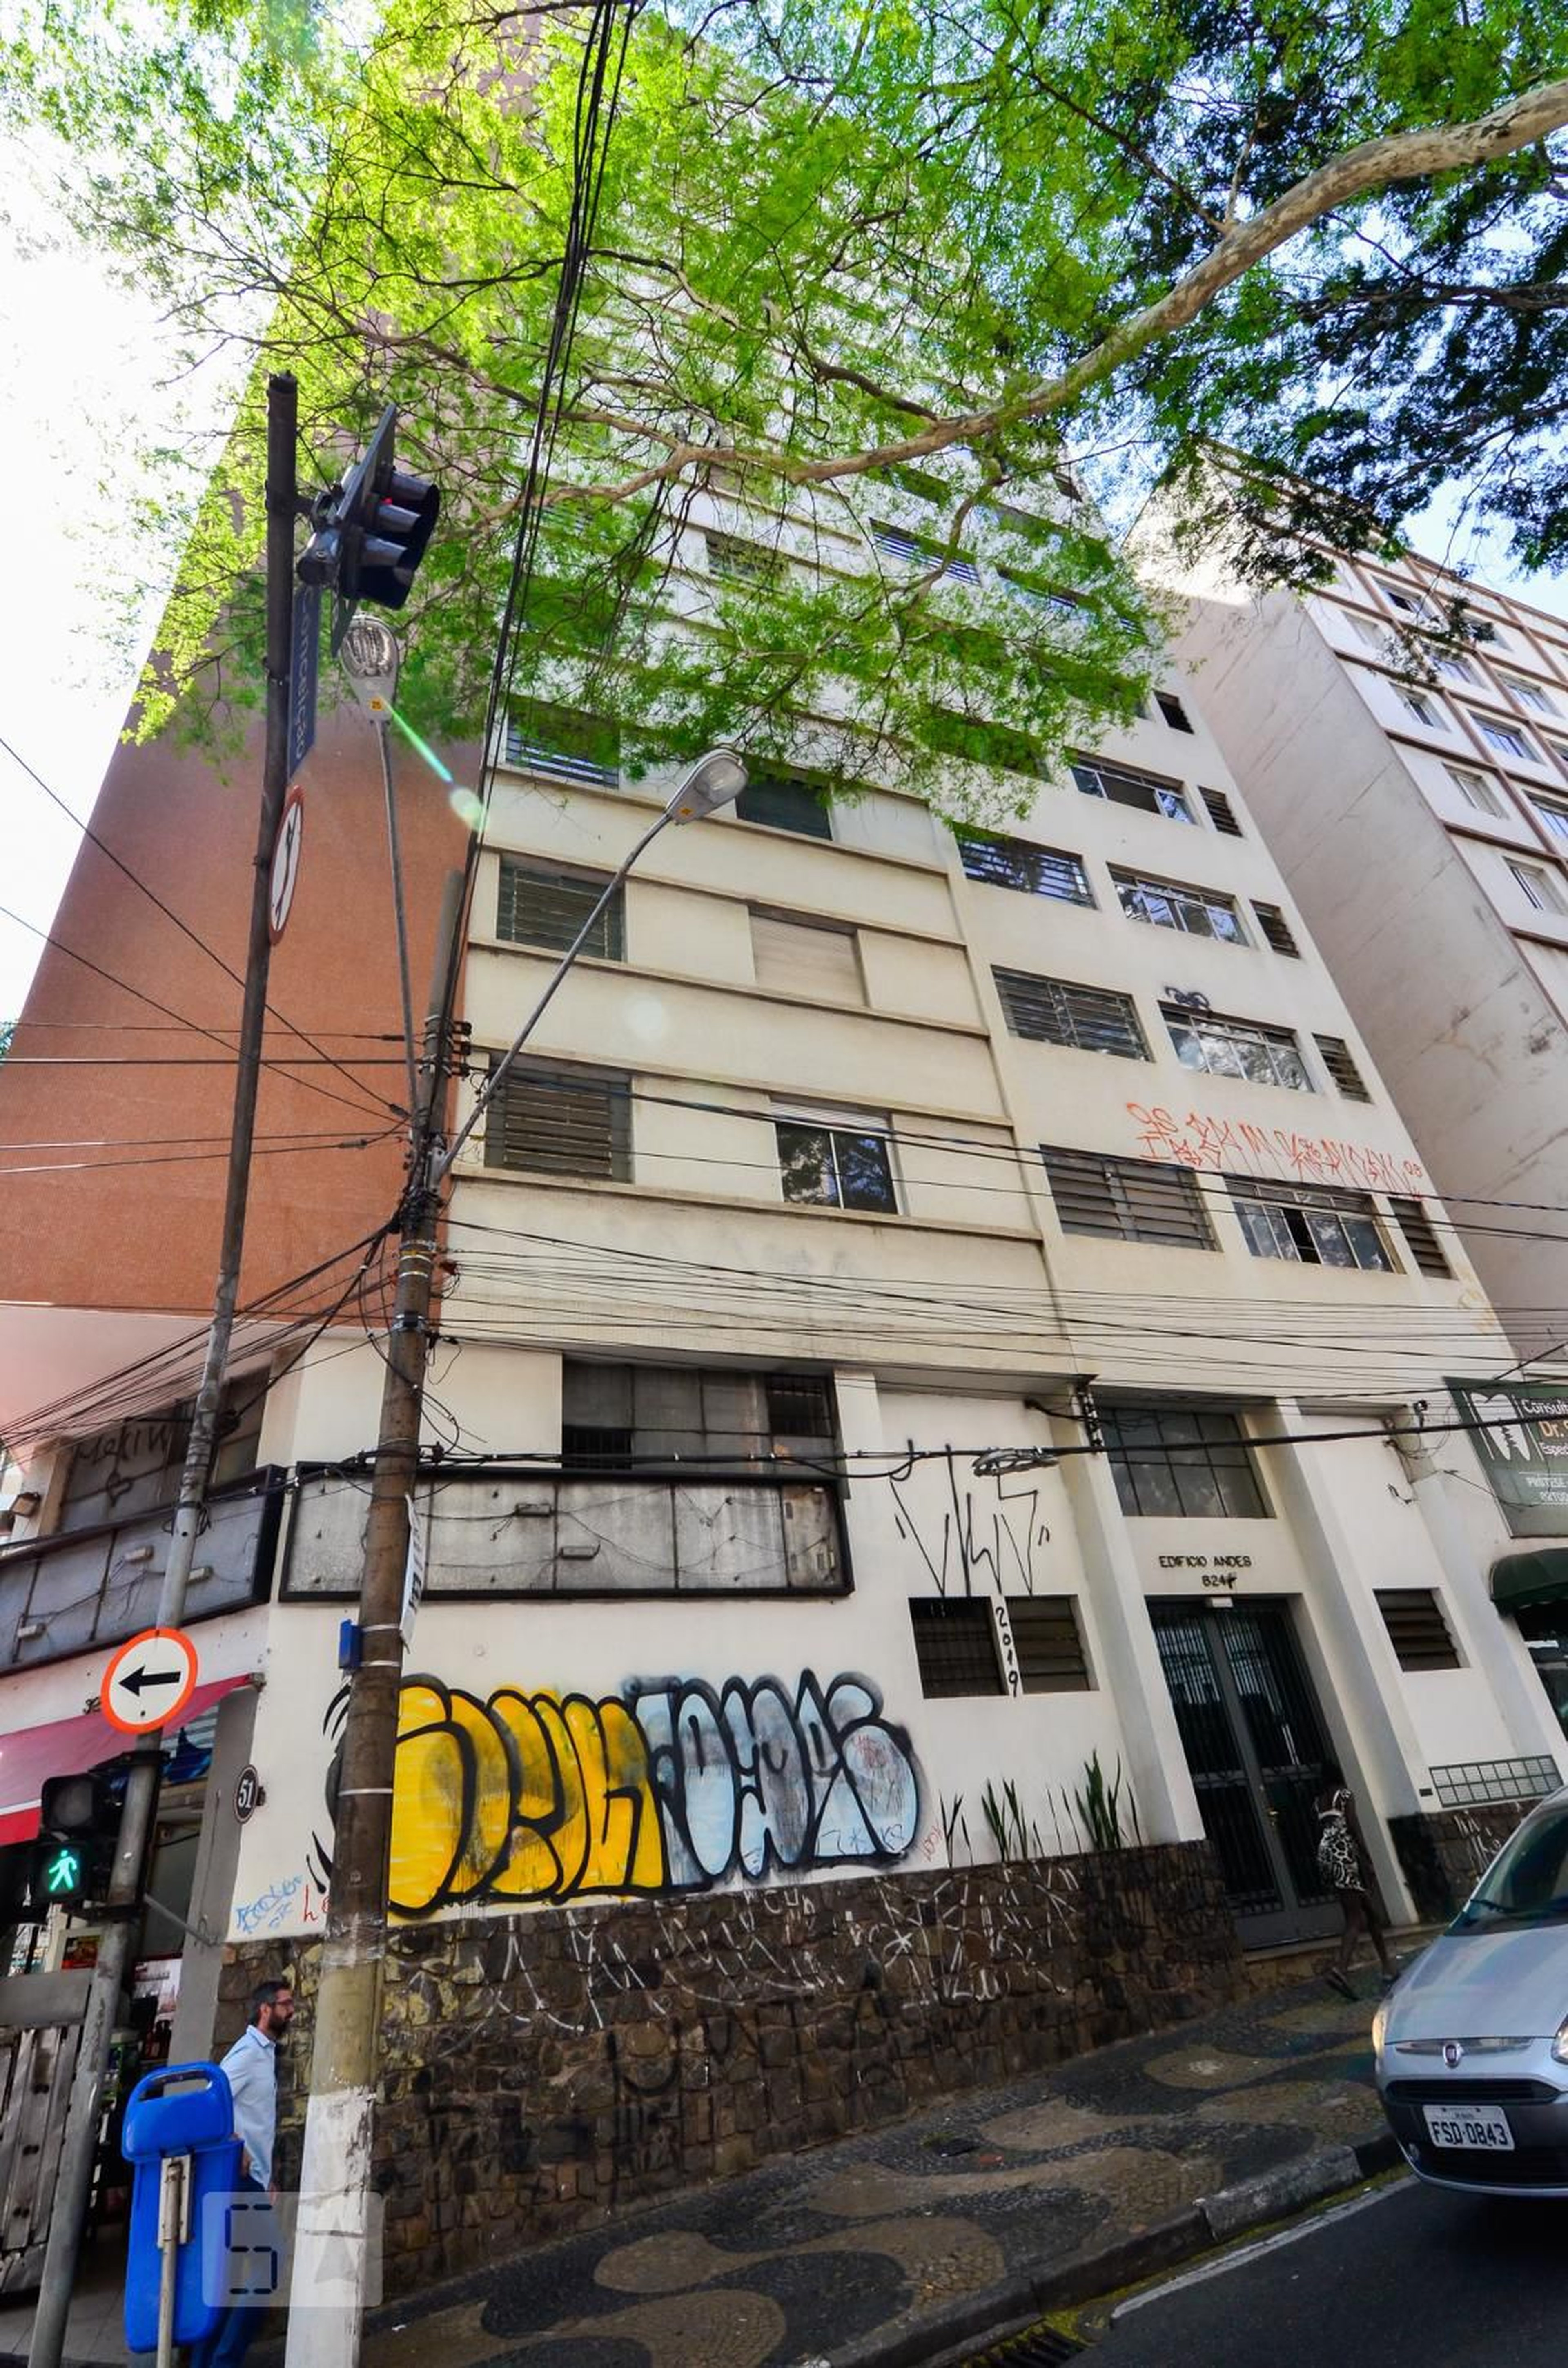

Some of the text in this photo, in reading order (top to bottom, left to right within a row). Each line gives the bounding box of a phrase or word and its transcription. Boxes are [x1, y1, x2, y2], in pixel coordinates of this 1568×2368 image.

[1538, 1421, 1564, 1437] Dr.
[1159, 1556, 1252, 1568] EDIFICIO ANDES
[238, 1779, 254, 1808] 51
